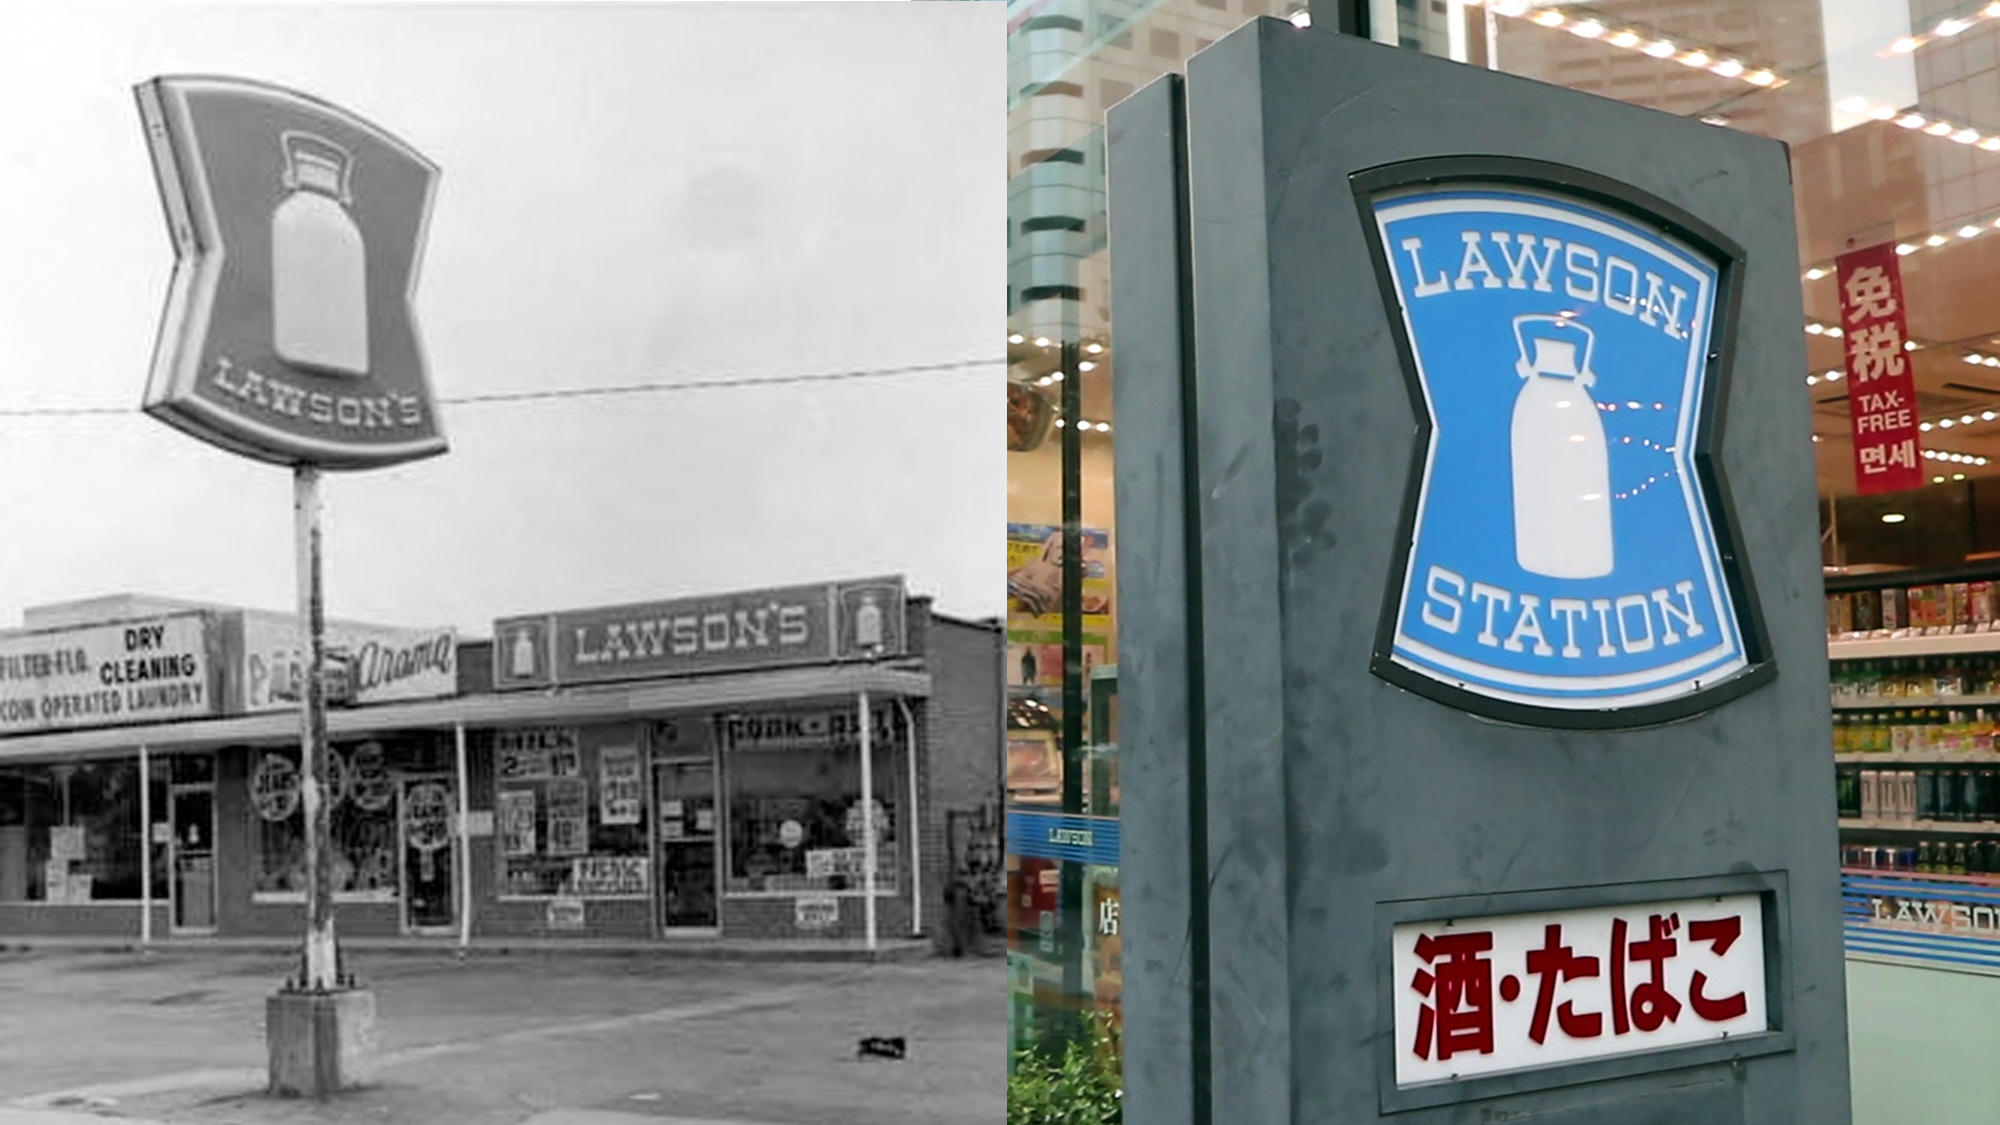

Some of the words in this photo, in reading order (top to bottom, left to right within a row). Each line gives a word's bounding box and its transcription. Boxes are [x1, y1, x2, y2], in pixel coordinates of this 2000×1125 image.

[1401, 231, 1688, 340] LAWSON
[1845, 265, 1905, 383] 免税
[212, 355, 422, 428] LAWSON'S
[1858, 389, 1905, 414] TAX-
[1857, 409, 1913, 434] FREE
[1860, 439, 1917, 474] 면세
[1421, 564, 1703, 658] STATION
[125, 625, 164, 652] DRY
[575, 602, 807, 664] LAWSON'S
[100, 653, 196, 685] CLEANING
[0, 698, 35, 722] COIN
[41, 690, 121, 719] OPERATED
[126, 682, 202, 712] LAUNDRY
